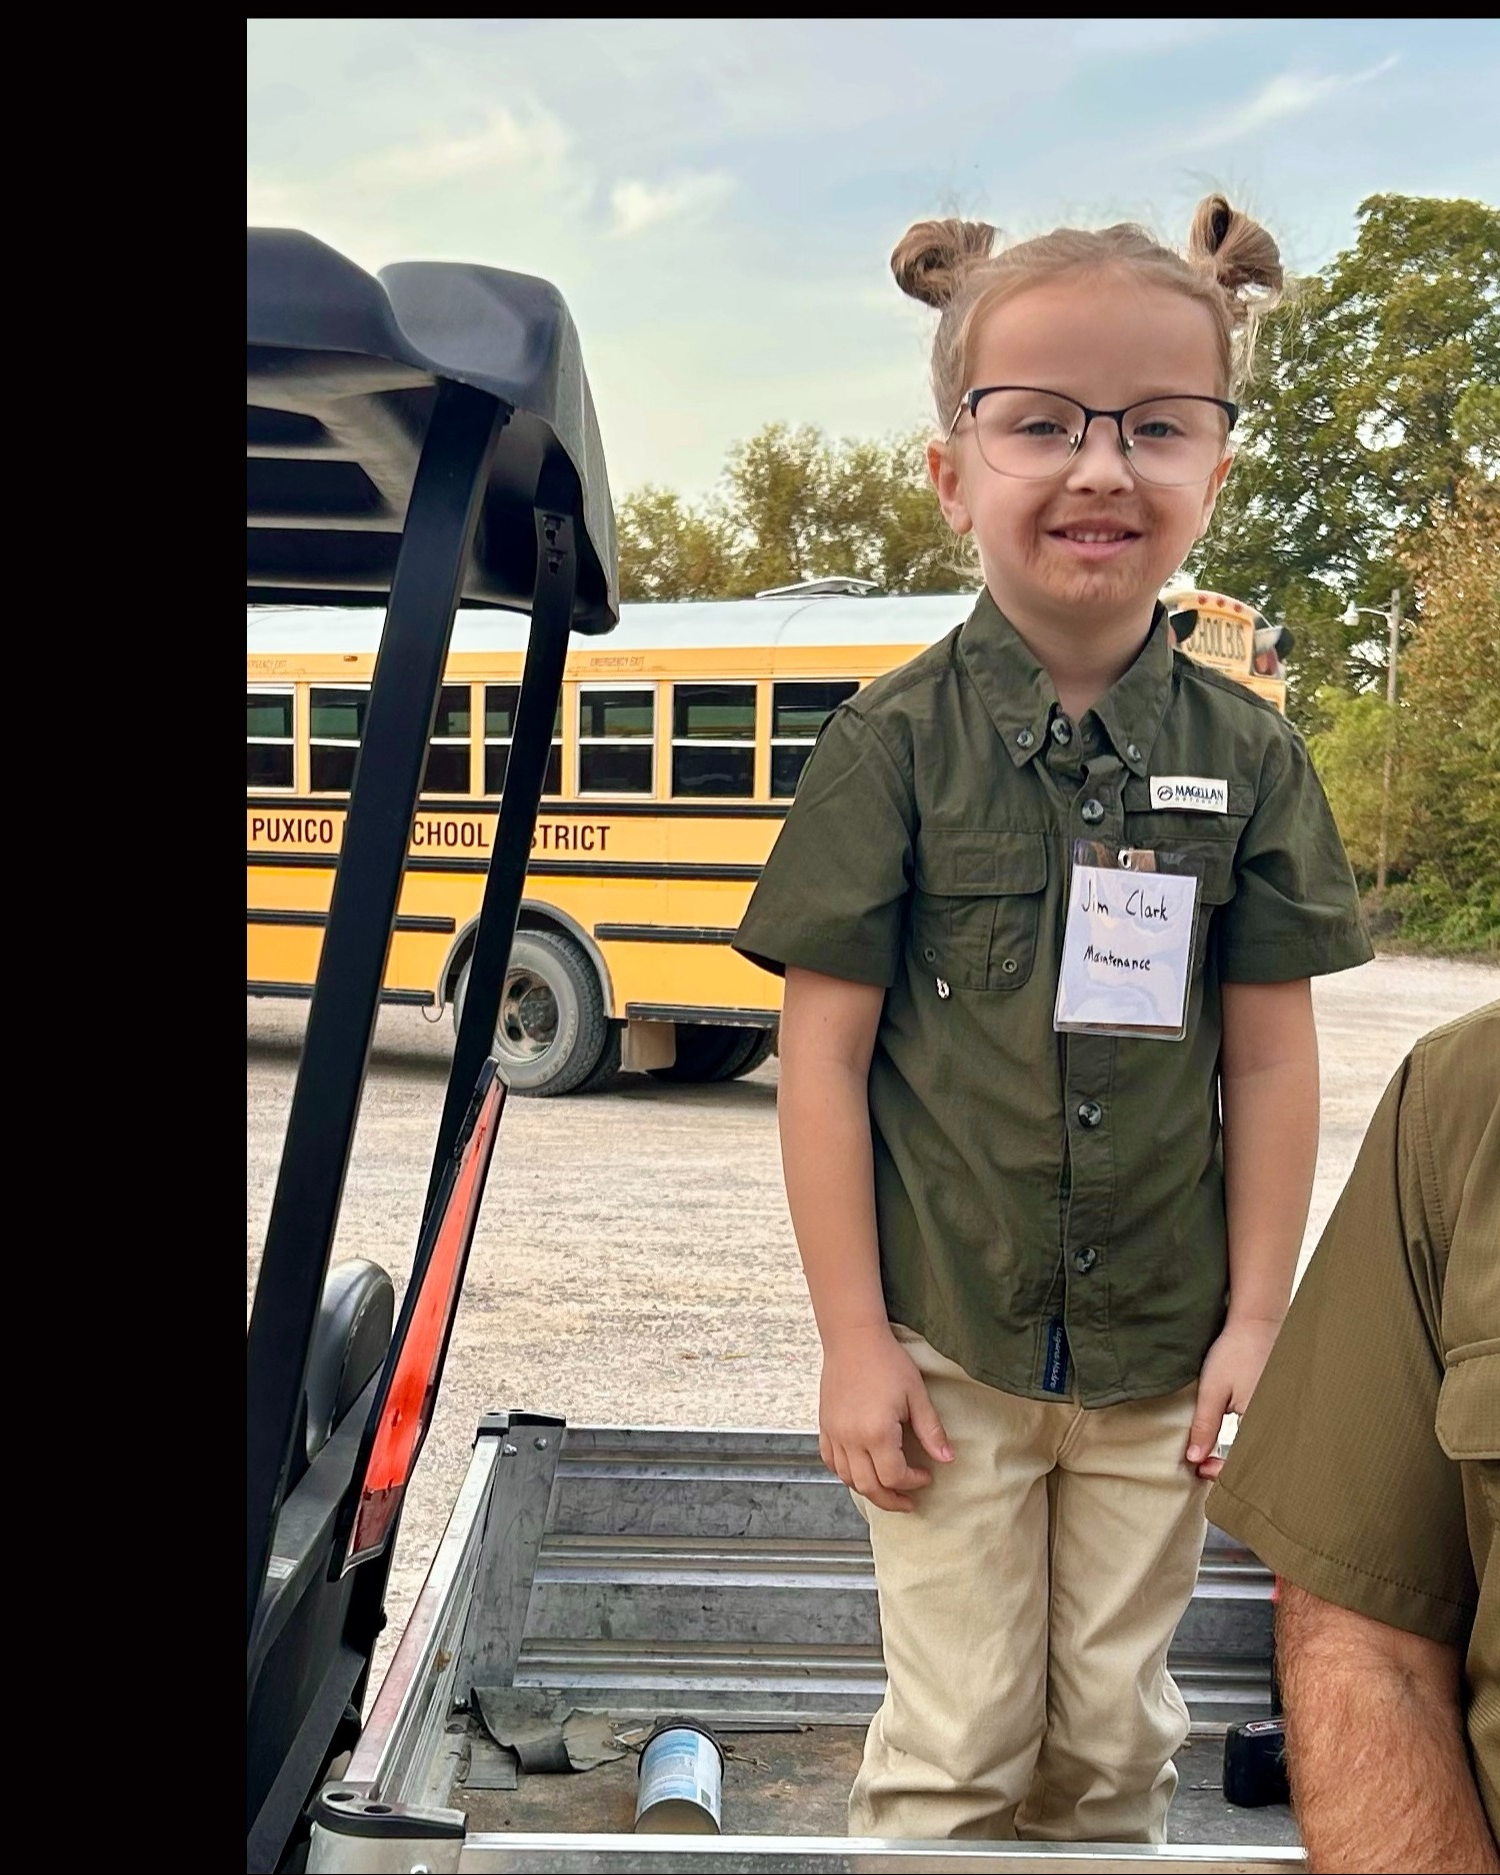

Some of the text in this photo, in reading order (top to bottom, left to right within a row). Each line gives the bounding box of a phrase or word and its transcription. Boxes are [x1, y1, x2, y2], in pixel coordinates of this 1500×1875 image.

[252, 817, 334, 844] PUXICO
[411, 821, 490, 848] CHOOL
[531, 824, 611, 851] TRICT
[1081, 879, 1168, 921] Jim Clark
[1083, 944, 1151, 971] Maintenance
